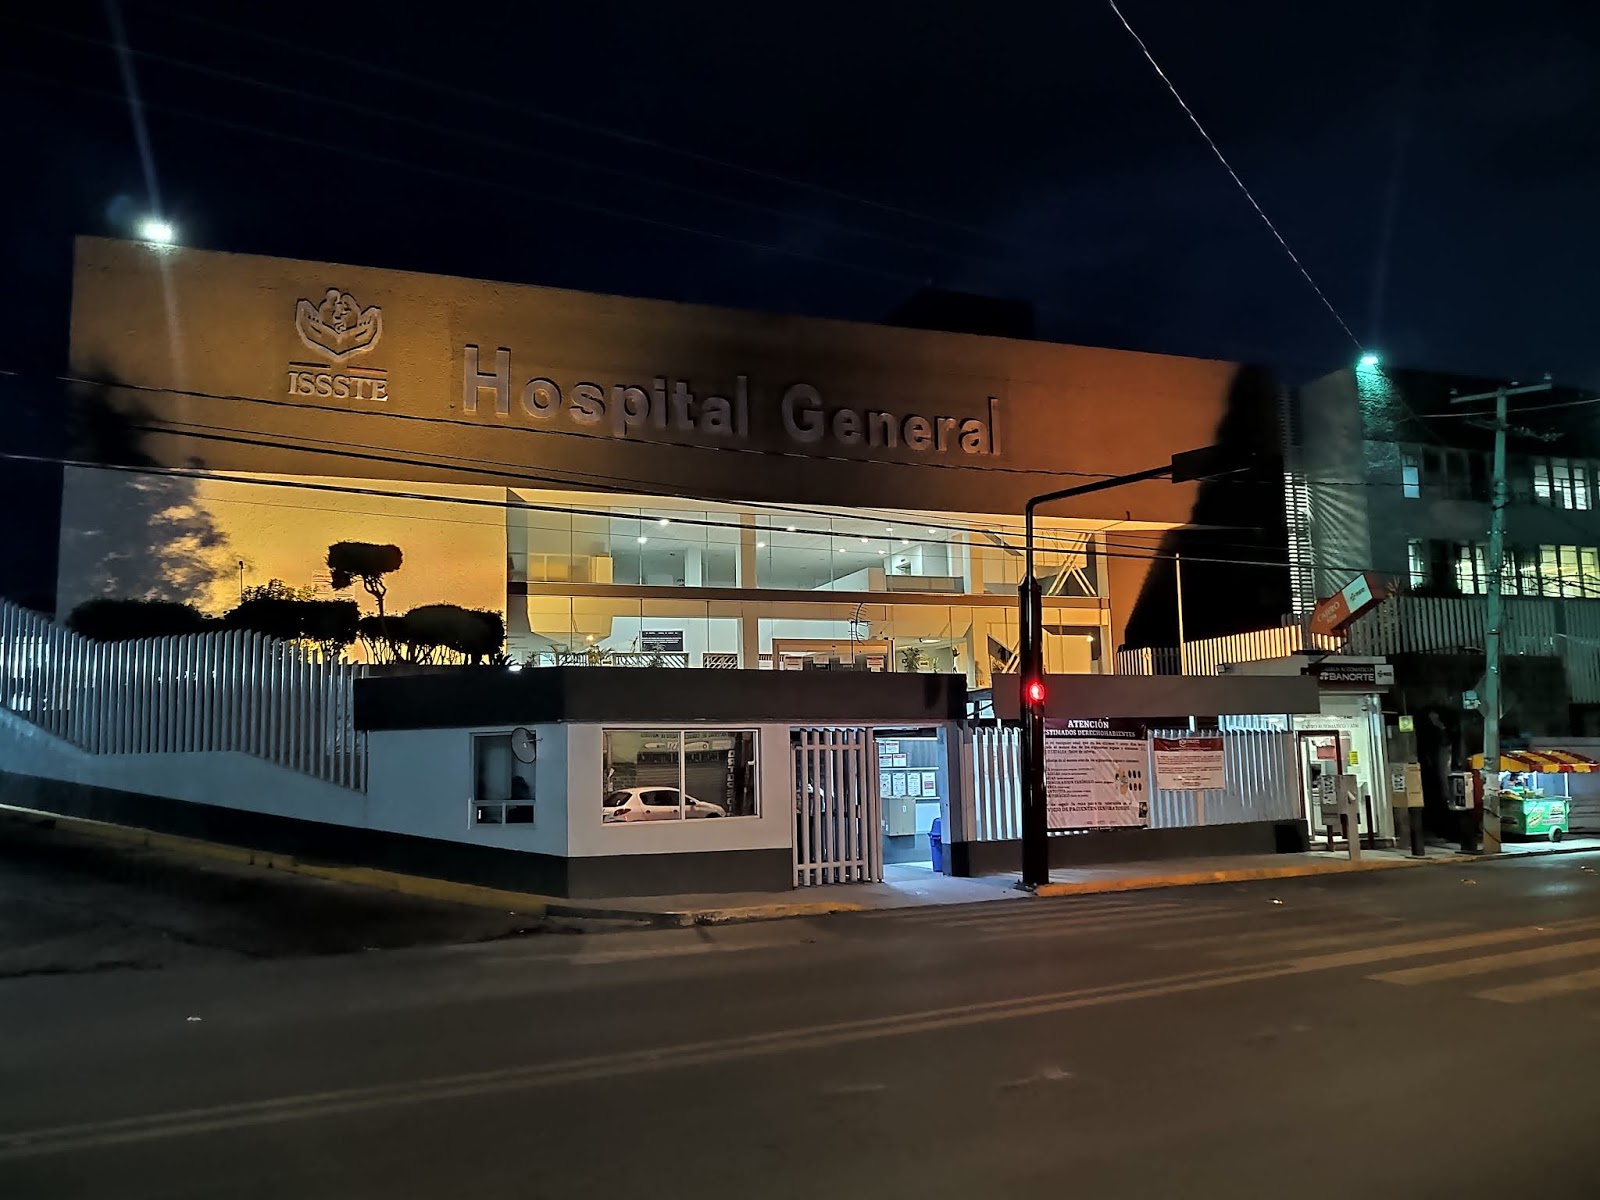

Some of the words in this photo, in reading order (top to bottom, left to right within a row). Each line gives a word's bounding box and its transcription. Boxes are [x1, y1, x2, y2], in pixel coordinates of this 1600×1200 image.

[288, 371, 388, 401] ISSSTE
[463, 344, 748, 437] Hospital
[781, 382, 1001, 455] General
[1329, 673, 1374, 681] BANORTE
[1067, 719, 1109, 729] ATENCIÓN
